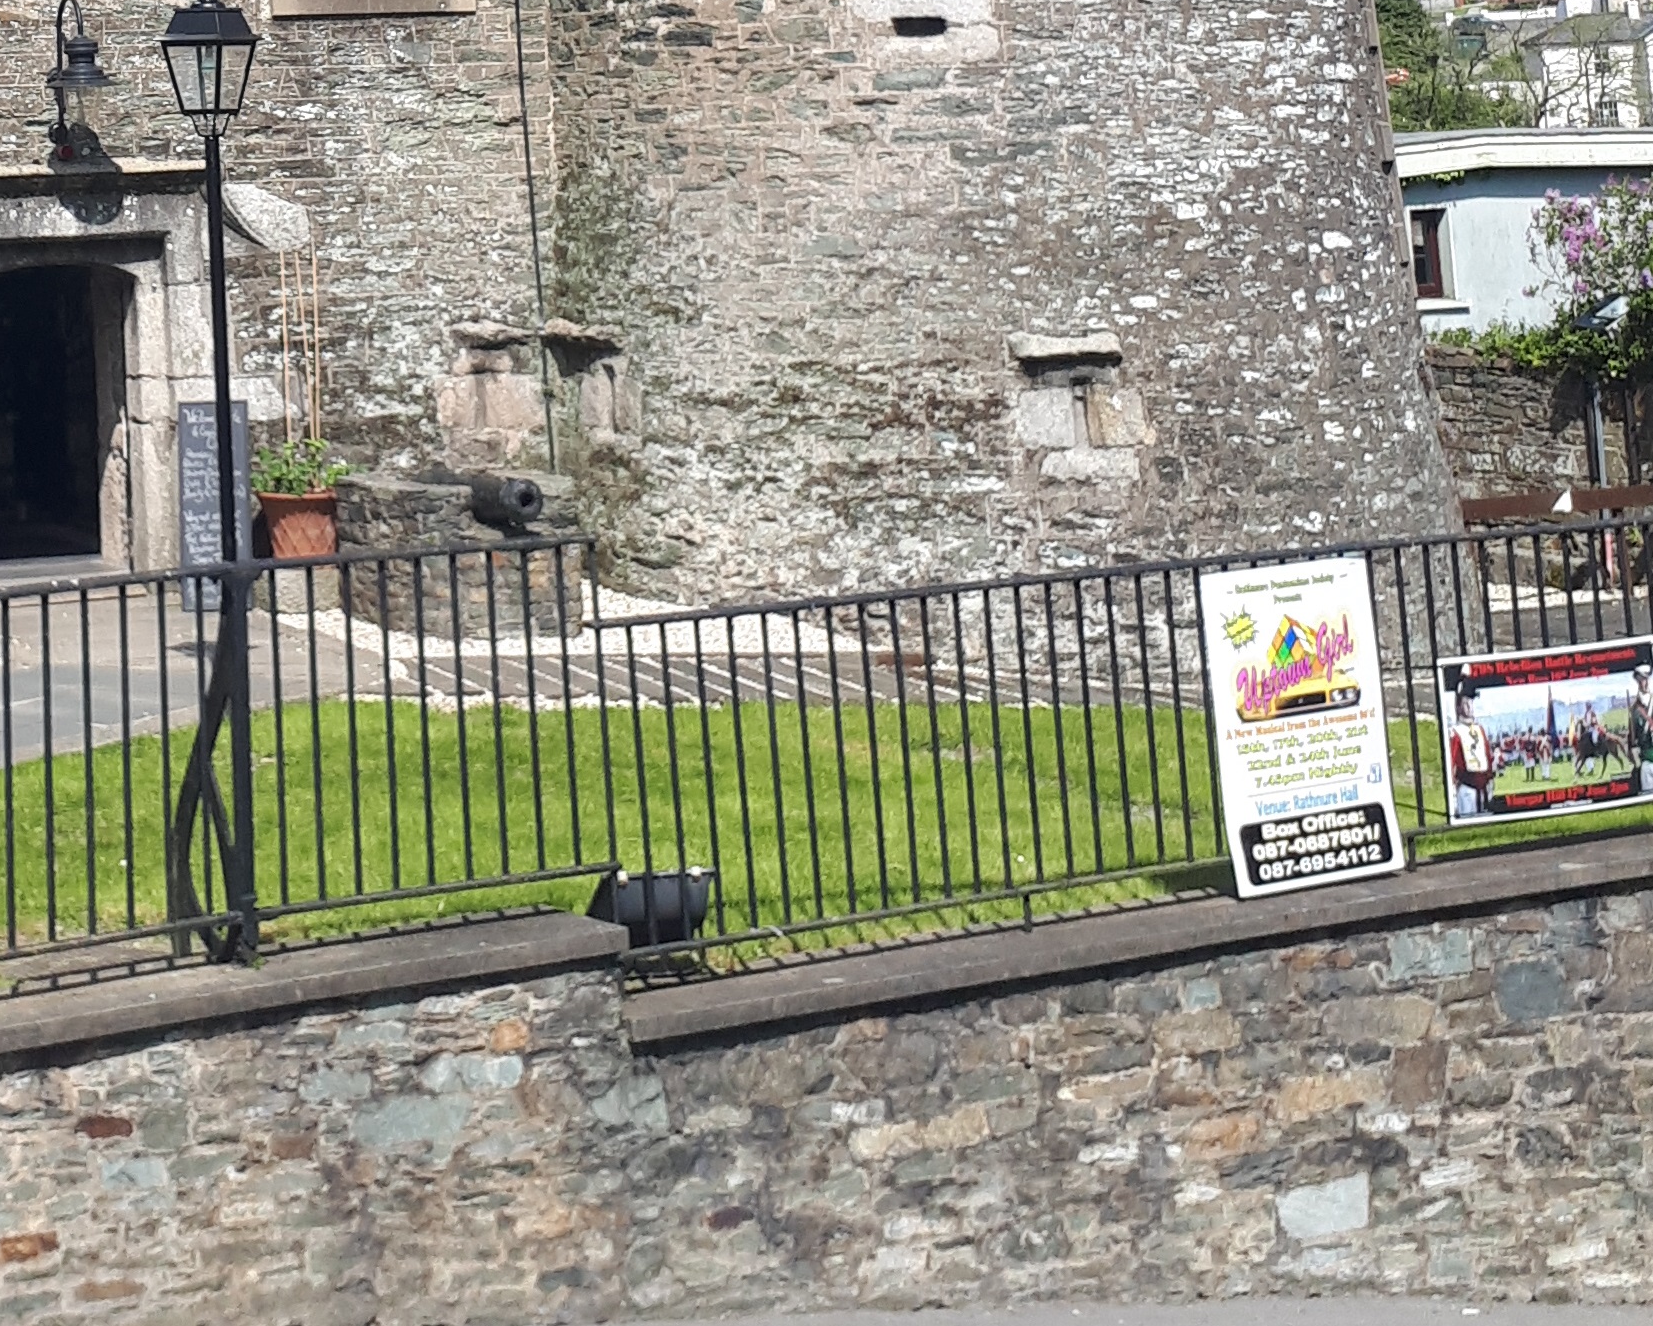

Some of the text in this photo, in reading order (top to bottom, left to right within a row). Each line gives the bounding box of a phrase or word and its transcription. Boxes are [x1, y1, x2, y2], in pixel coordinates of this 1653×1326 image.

[1236, 654, 1313, 717] Uptown
[1315, 613, 1354, 683] Girl
[1225, 729, 1233, 740] A
[1234, 728, 1253, 740] New
[1255, 722, 1285, 736] Musical
[1308, 717, 1321, 728] the
[1285, 753, 1296, 766] &
[1332, 745, 1362, 759] June
[1308, 761, 1359, 781] Nightly
[1255, 800, 1291, 817] Venue:
[1340, 783, 1359, 803] Hall
[1261, 809, 1366, 840] Box Office:
